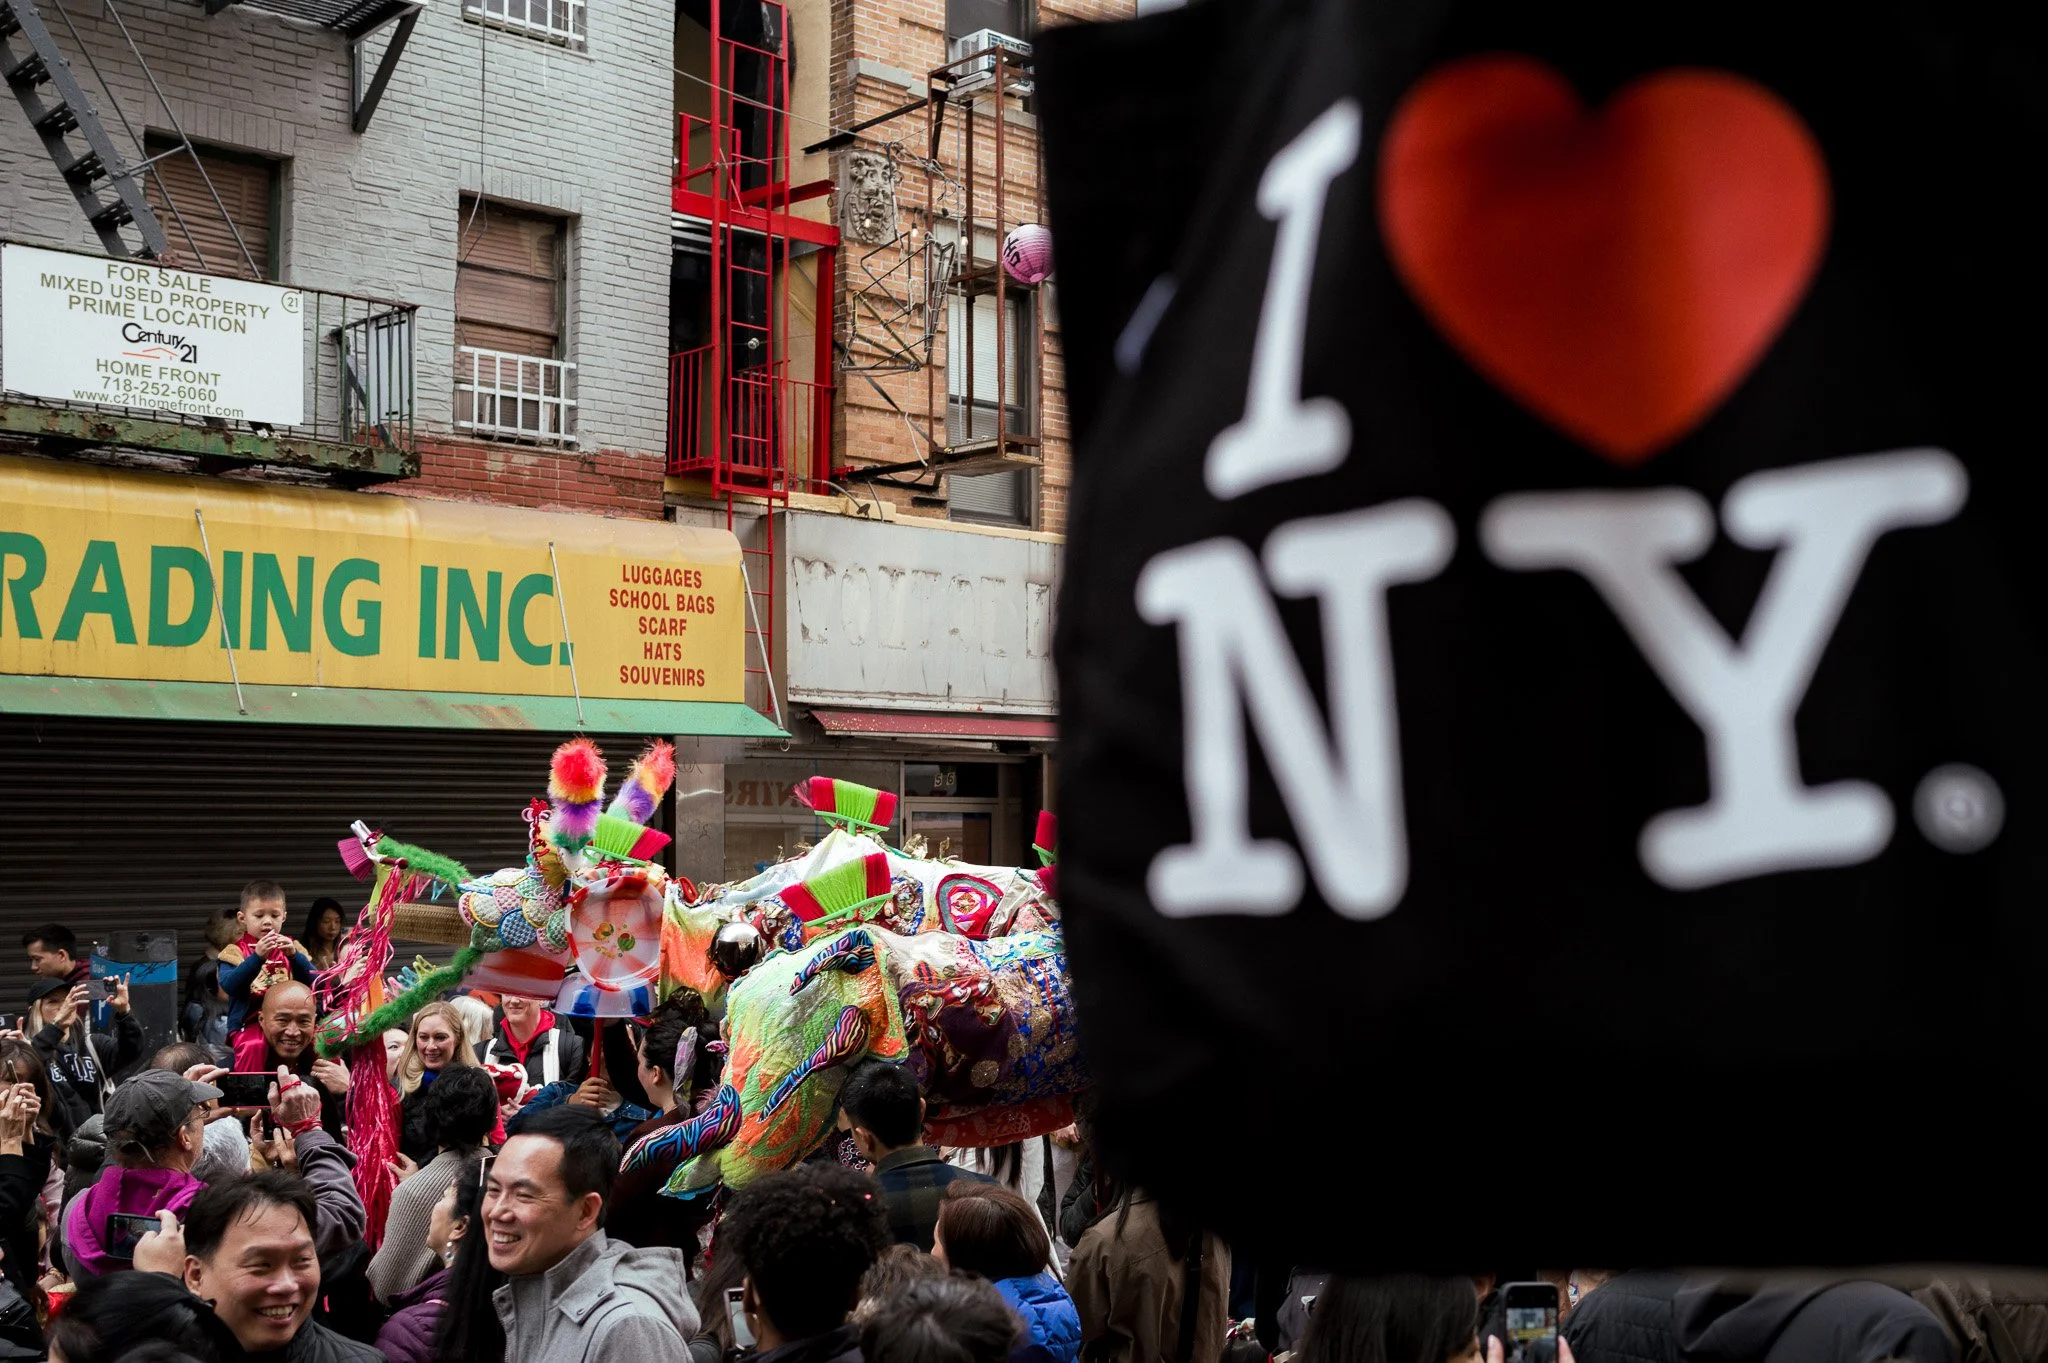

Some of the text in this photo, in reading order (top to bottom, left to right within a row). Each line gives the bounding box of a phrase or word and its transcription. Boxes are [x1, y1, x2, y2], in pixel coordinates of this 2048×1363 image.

[107, 263, 211, 294] FOR SALE
[40, 272, 270, 320] MIXED USED PROPERTY
[1206, 100, 1360, 497] I
[68, 294, 246, 334] PRIME LOCATION
[122, 322, 186, 349] Century
[180, 344, 197, 364] 21
[96, 358, 221, 386] HOME FRONT
[101, 376, 217, 402] 718-252-6060
[73, 389, 244, 418] www.c21homefront.com
[622, 564, 702, 589] LUGGAGES
[609, 588, 715, 615] SCHOOL BAGS
[419, 566, 573, 666] INC.
[638, 616, 687, 636] SCARF
[643, 641, 682, 661] HATS
[620, 664, 705, 687] SOUVENIRS
